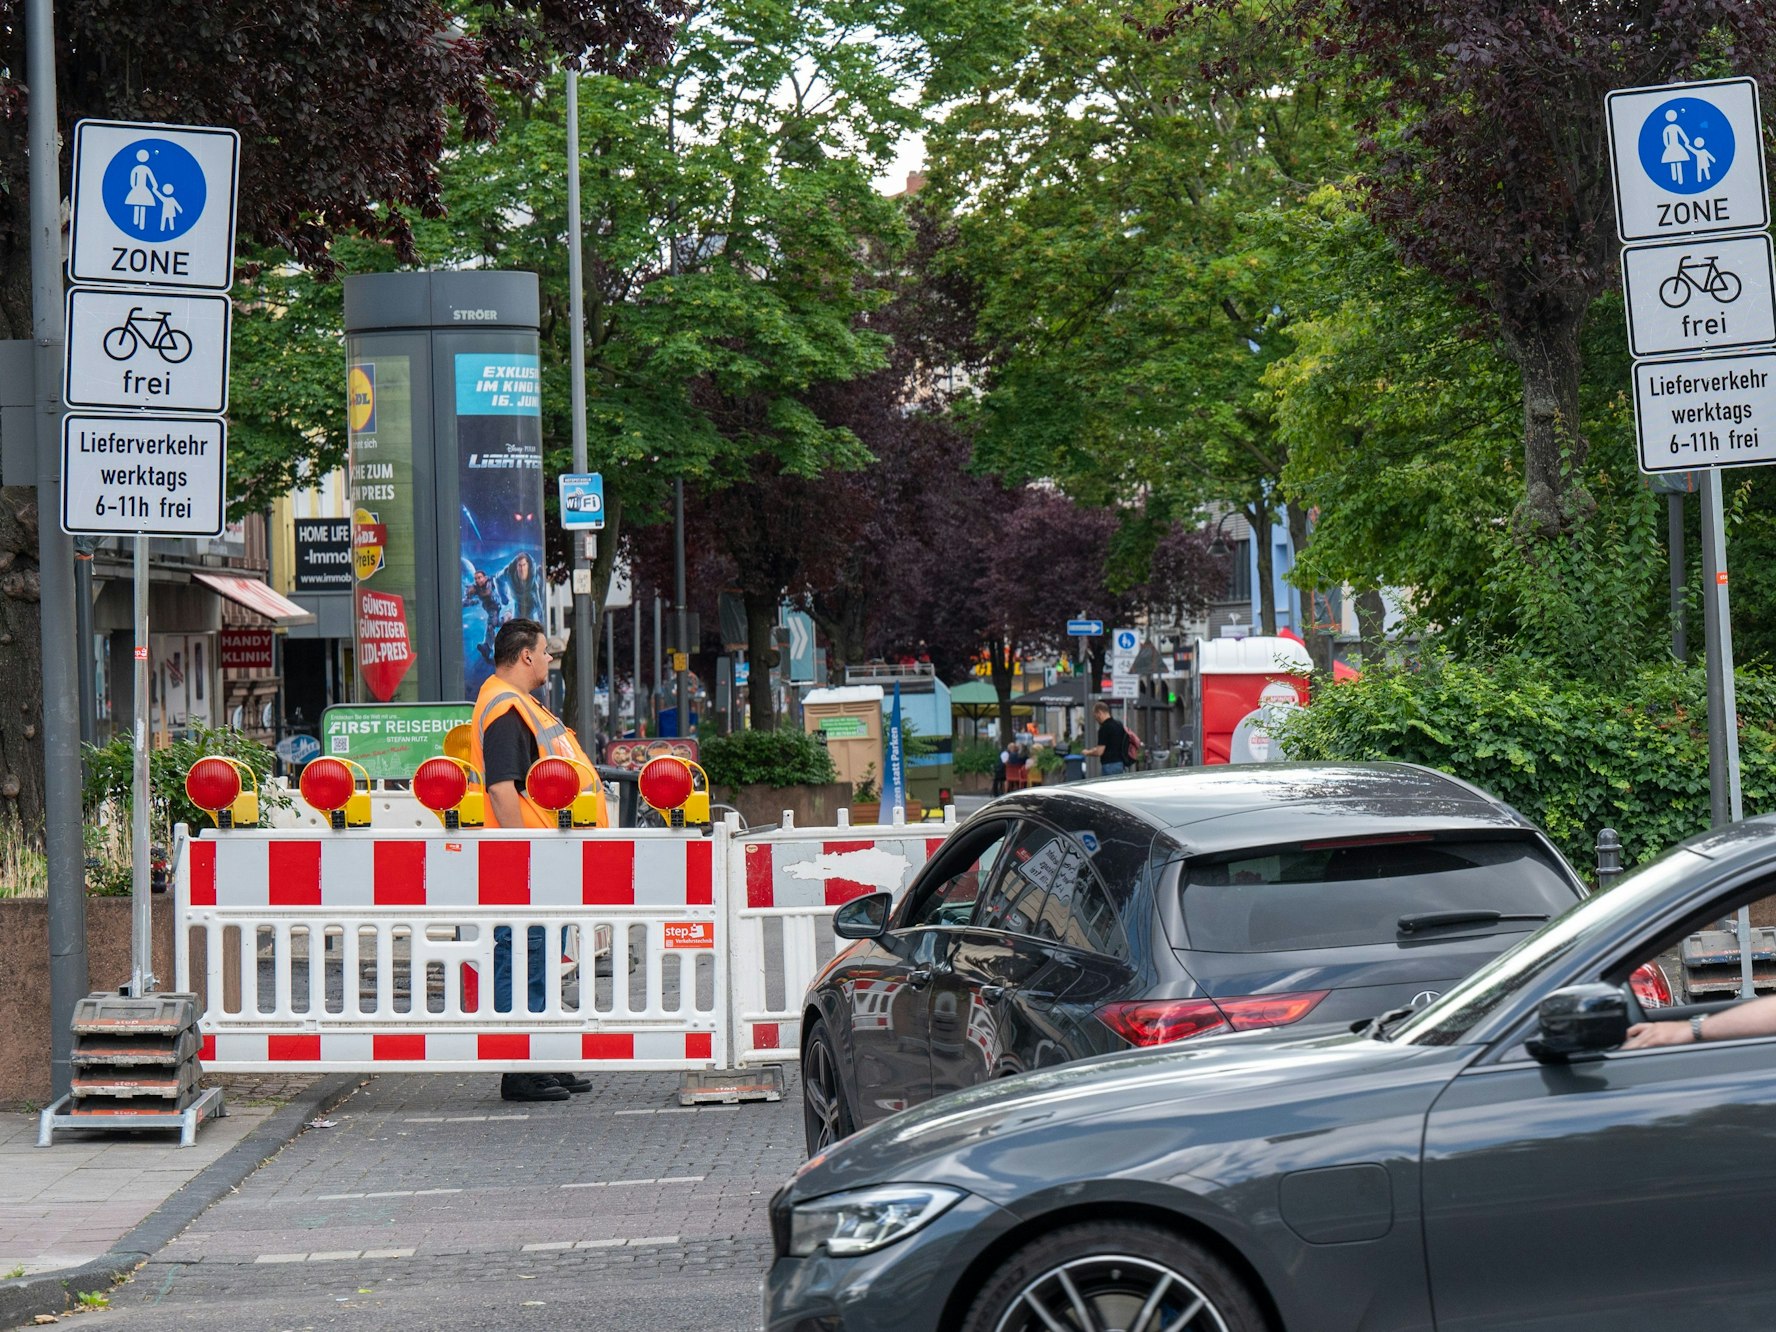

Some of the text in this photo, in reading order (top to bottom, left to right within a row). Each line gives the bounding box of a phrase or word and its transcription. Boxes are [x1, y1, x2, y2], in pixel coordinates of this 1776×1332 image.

[1657, 198, 1730, 227] ZONE
[111, 247, 190, 276] ZONE
[453, 309, 498, 321] STRÖER
[1682, 311, 1727, 338] frei
[123, 369, 171, 396] frei
[476, 381, 498, 392] IM
[1650, 369, 1769, 397] Lieferverkehr
[492, 395, 514, 407] 16.
[1671, 402, 1753, 426] werktags
[80, 432, 209, 456] Lieferverkehr
[364, 438, 378, 449] sich
[1669, 428, 1759, 454] 6-11h frei
[101, 465, 188, 492] werktags
[367, 463, 394, 480] ZUM
[361, 484, 395, 501] PREIS
[95, 495, 192, 519] 6-11h frei
[299, 525, 350, 542] HOME LIFE
[362, 594, 398, 617] GÜNSTIG
[360, 615, 406, 638] GÜNSTIGER
[222, 636, 271, 646] HANDY
[223, 652, 271, 662] KLINIK
[361, 641, 408, 666] LIDL-PREIS
[328, 720, 381, 734] FIRST
[889, 727, 900, 761] Parken
[665, 926, 689, 938] step
